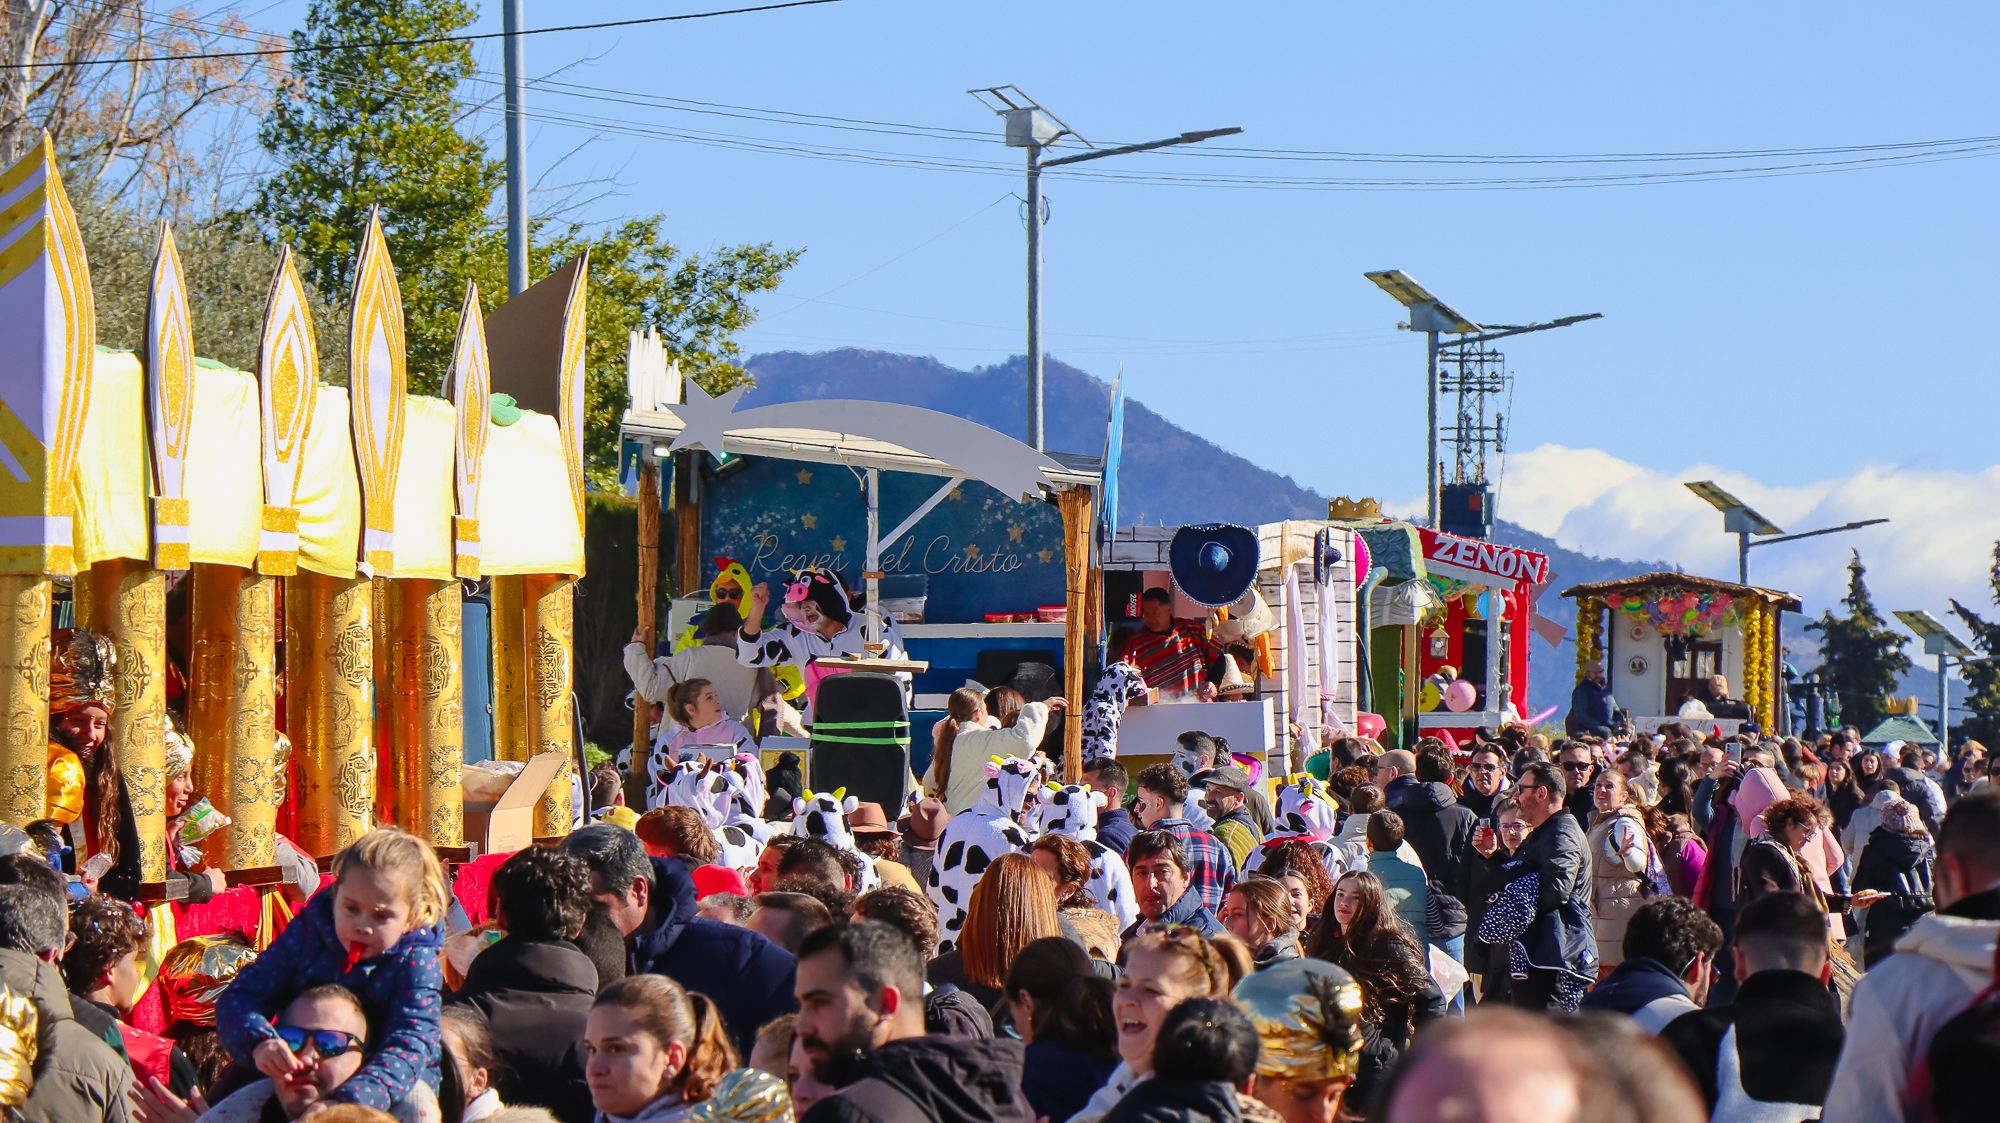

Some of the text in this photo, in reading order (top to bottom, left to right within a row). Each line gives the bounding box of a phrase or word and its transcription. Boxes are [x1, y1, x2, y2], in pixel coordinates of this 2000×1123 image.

[862, 535, 912, 572] el
[924, 535, 1024, 574] Cristo
[1432, 533, 1543, 584] ZENÓN
[1129, 593, 1137, 617] 2500W
